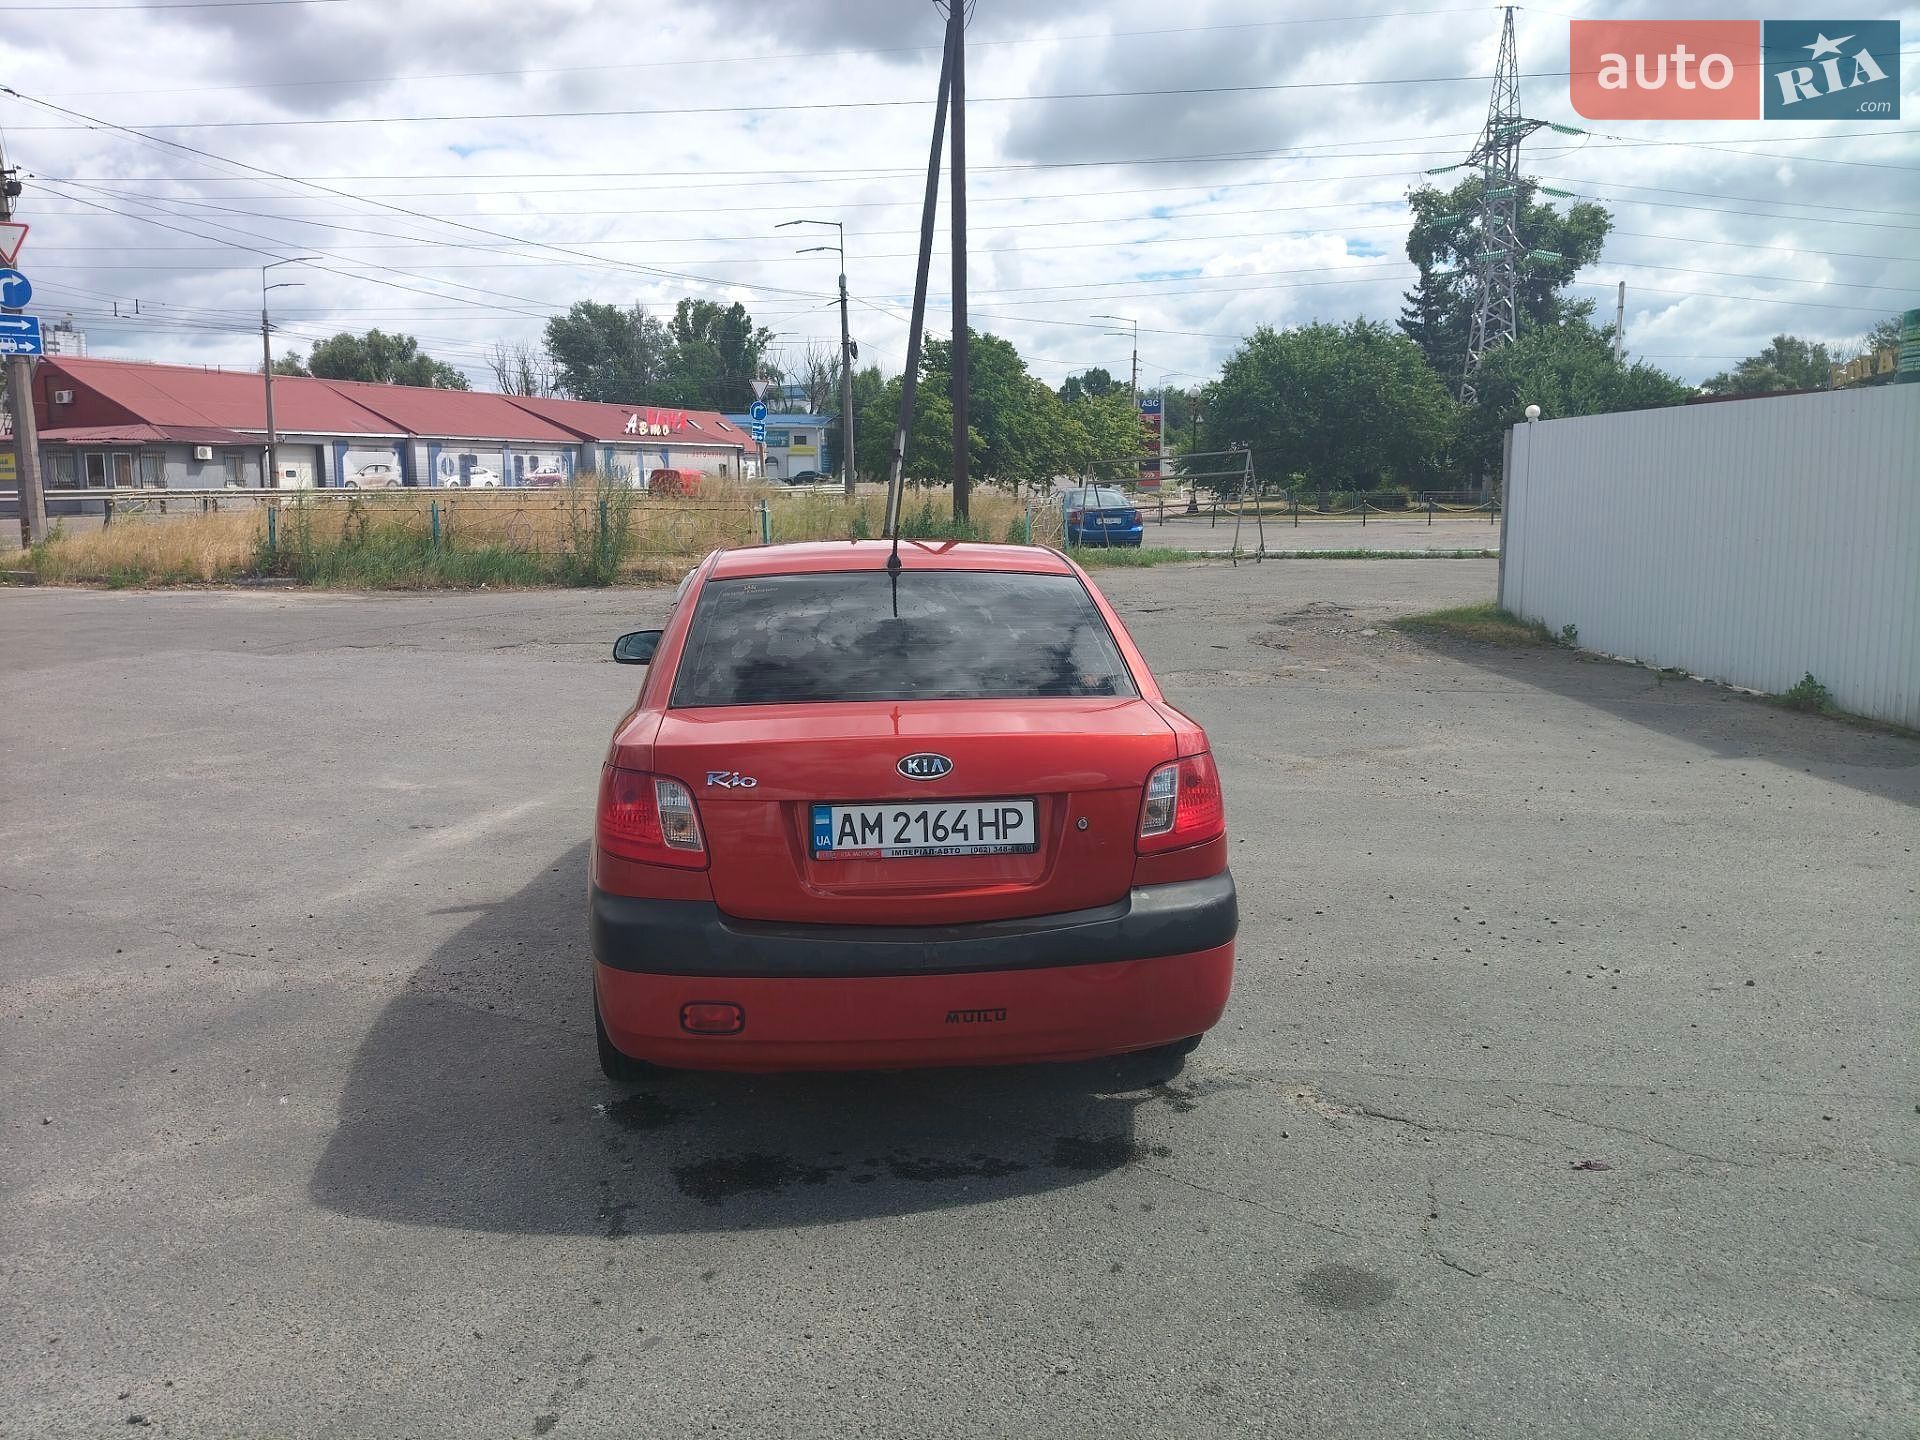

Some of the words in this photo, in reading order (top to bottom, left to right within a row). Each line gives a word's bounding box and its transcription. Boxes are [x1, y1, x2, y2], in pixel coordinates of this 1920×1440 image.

[1141, 399, 1159, 407] АЗС
[907, 759, 945, 773] KIA
[705, 771, 758, 789] Rio
[837, 812, 883, 846] AM
[893, 809, 969, 844] 2164
[978, 807, 1024, 841] HP
[816, 836, 831, 846] UA
